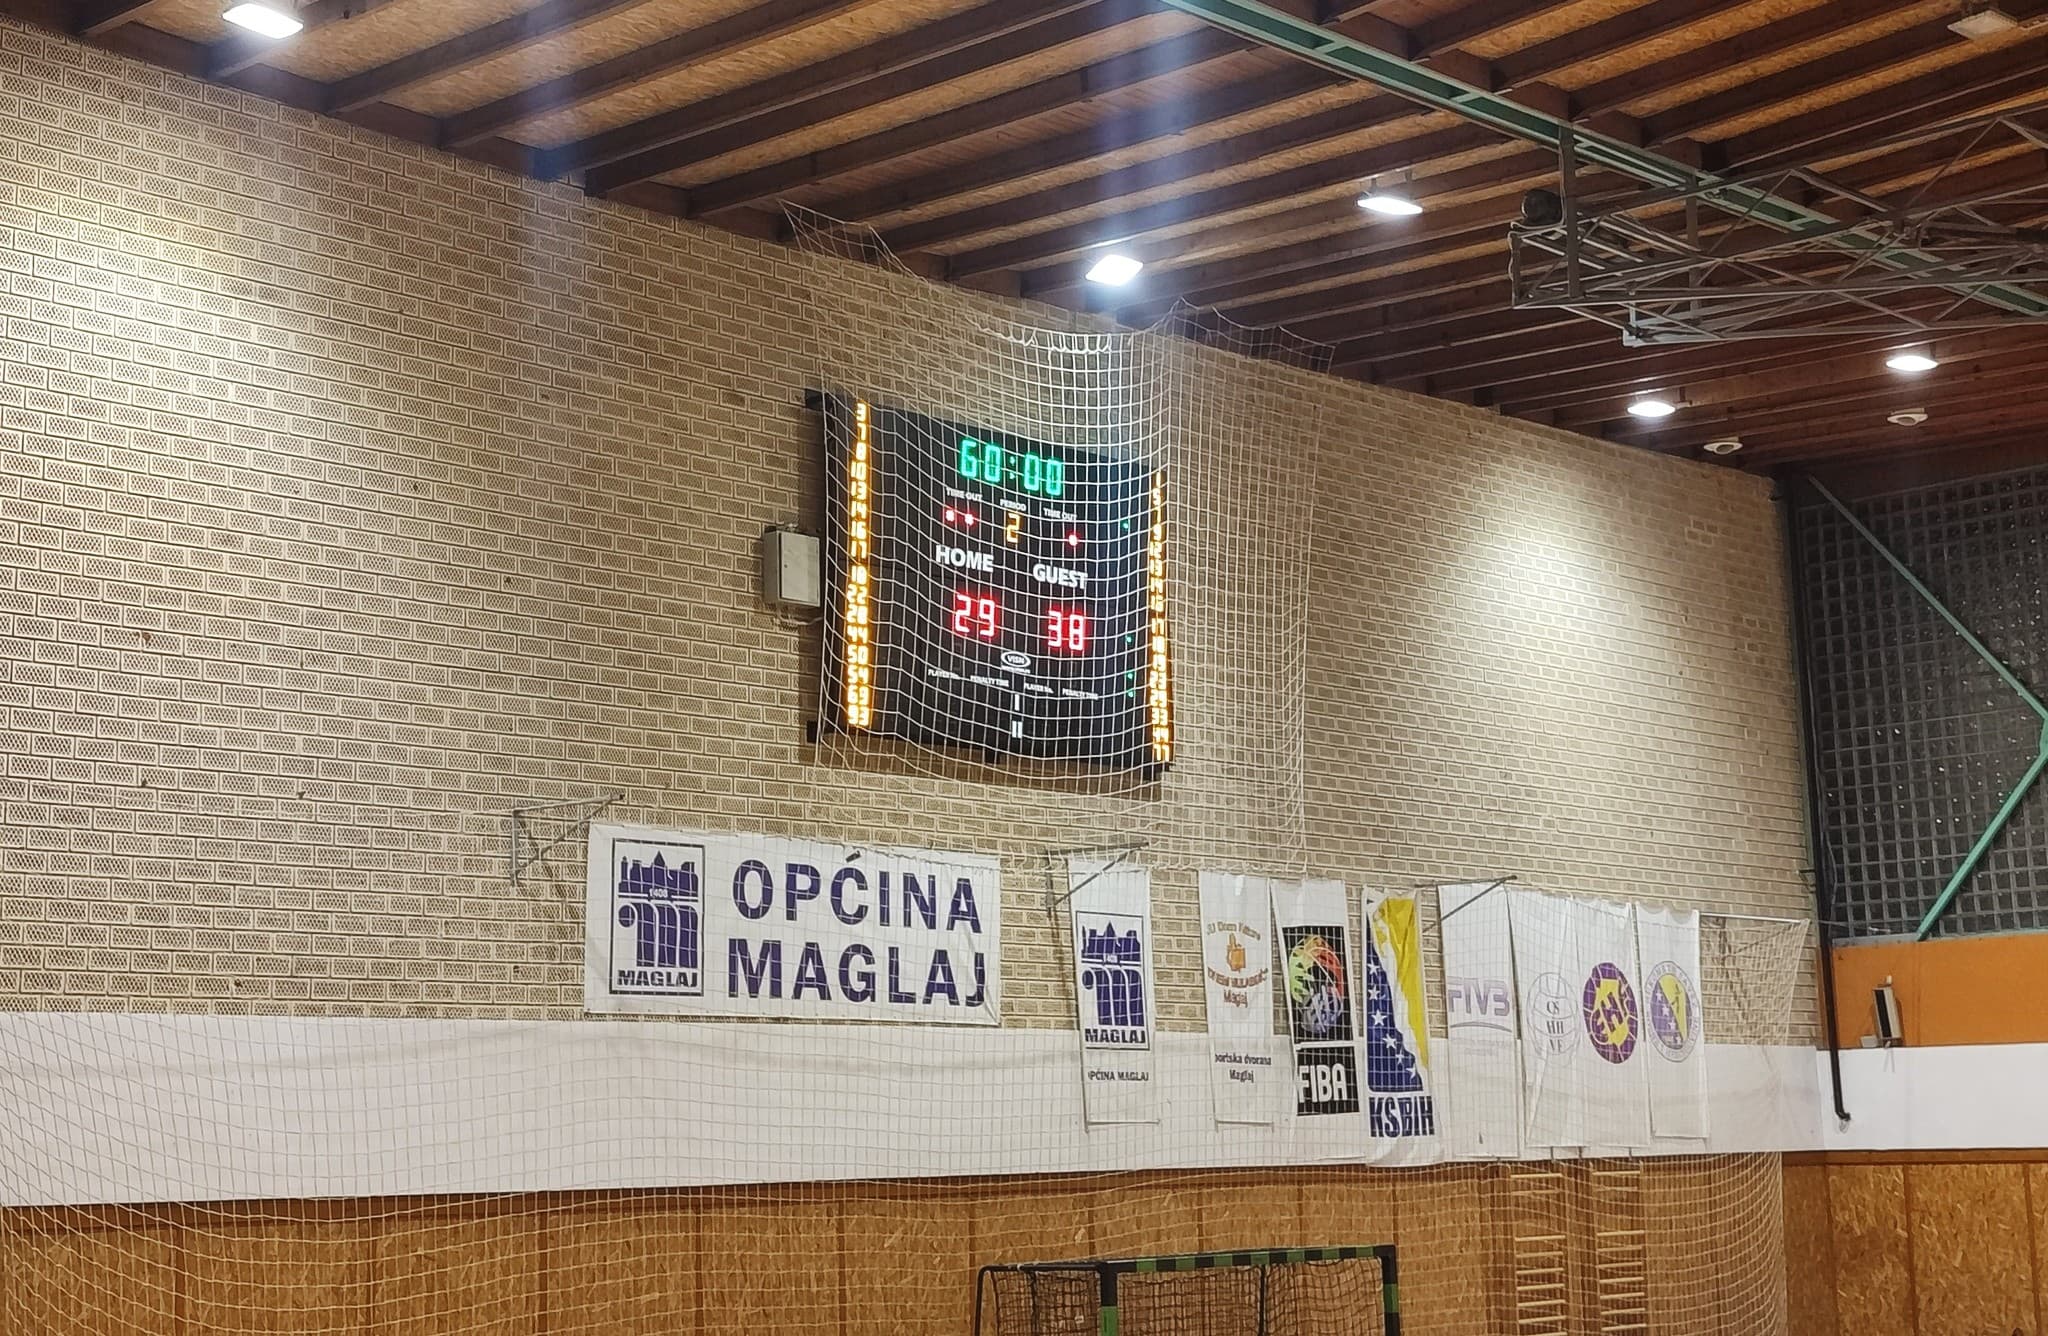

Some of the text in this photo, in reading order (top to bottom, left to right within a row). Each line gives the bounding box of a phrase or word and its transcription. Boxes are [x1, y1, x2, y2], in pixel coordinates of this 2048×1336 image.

[857, 403, 866, 421] 3
[857, 423, 866, 440] 7
[856, 442, 866, 460] 8
[851, 461, 866, 480] 10
[961, 439, 1062, 496] 60:00
[851, 481, 866, 500] 13
[851, 501, 866, 519] 14
[851, 521, 866, 540] 16
[1006, 512, 1020, 543] 2
[851, 541, 866, 559] 17
[935, 544, 994, 573] HOME
[1033, 564, 1088, 589] GUEST
[847, 584, 867, 604] 22
[955, 594, 995, 637] 29
[847, 625, 868, 644] 44
[1048, 611, 1084, 651] 38
[1152, 618, 1164, 635] 17
[848, 644, 868, 665] 50
[848, 664, 868, 684] 54
[1153, 744, 1169, 762] 77
[732, 850, 982, 933] OPĆINA
[617, 970, 698, 988] MAGLAJ
[728, 938, 985, 1007] MAGLAJ
[1447, 976, 1510, 1016] FIVB
[1085, 1028, 1146, 1044] MAGLAJ
[1117, 1071, 1149, 1082] MAGLAJ
[1298, 1063, 1348, 1103] FIBA
[1369, 1096, 1434, 1137] KSBIH
